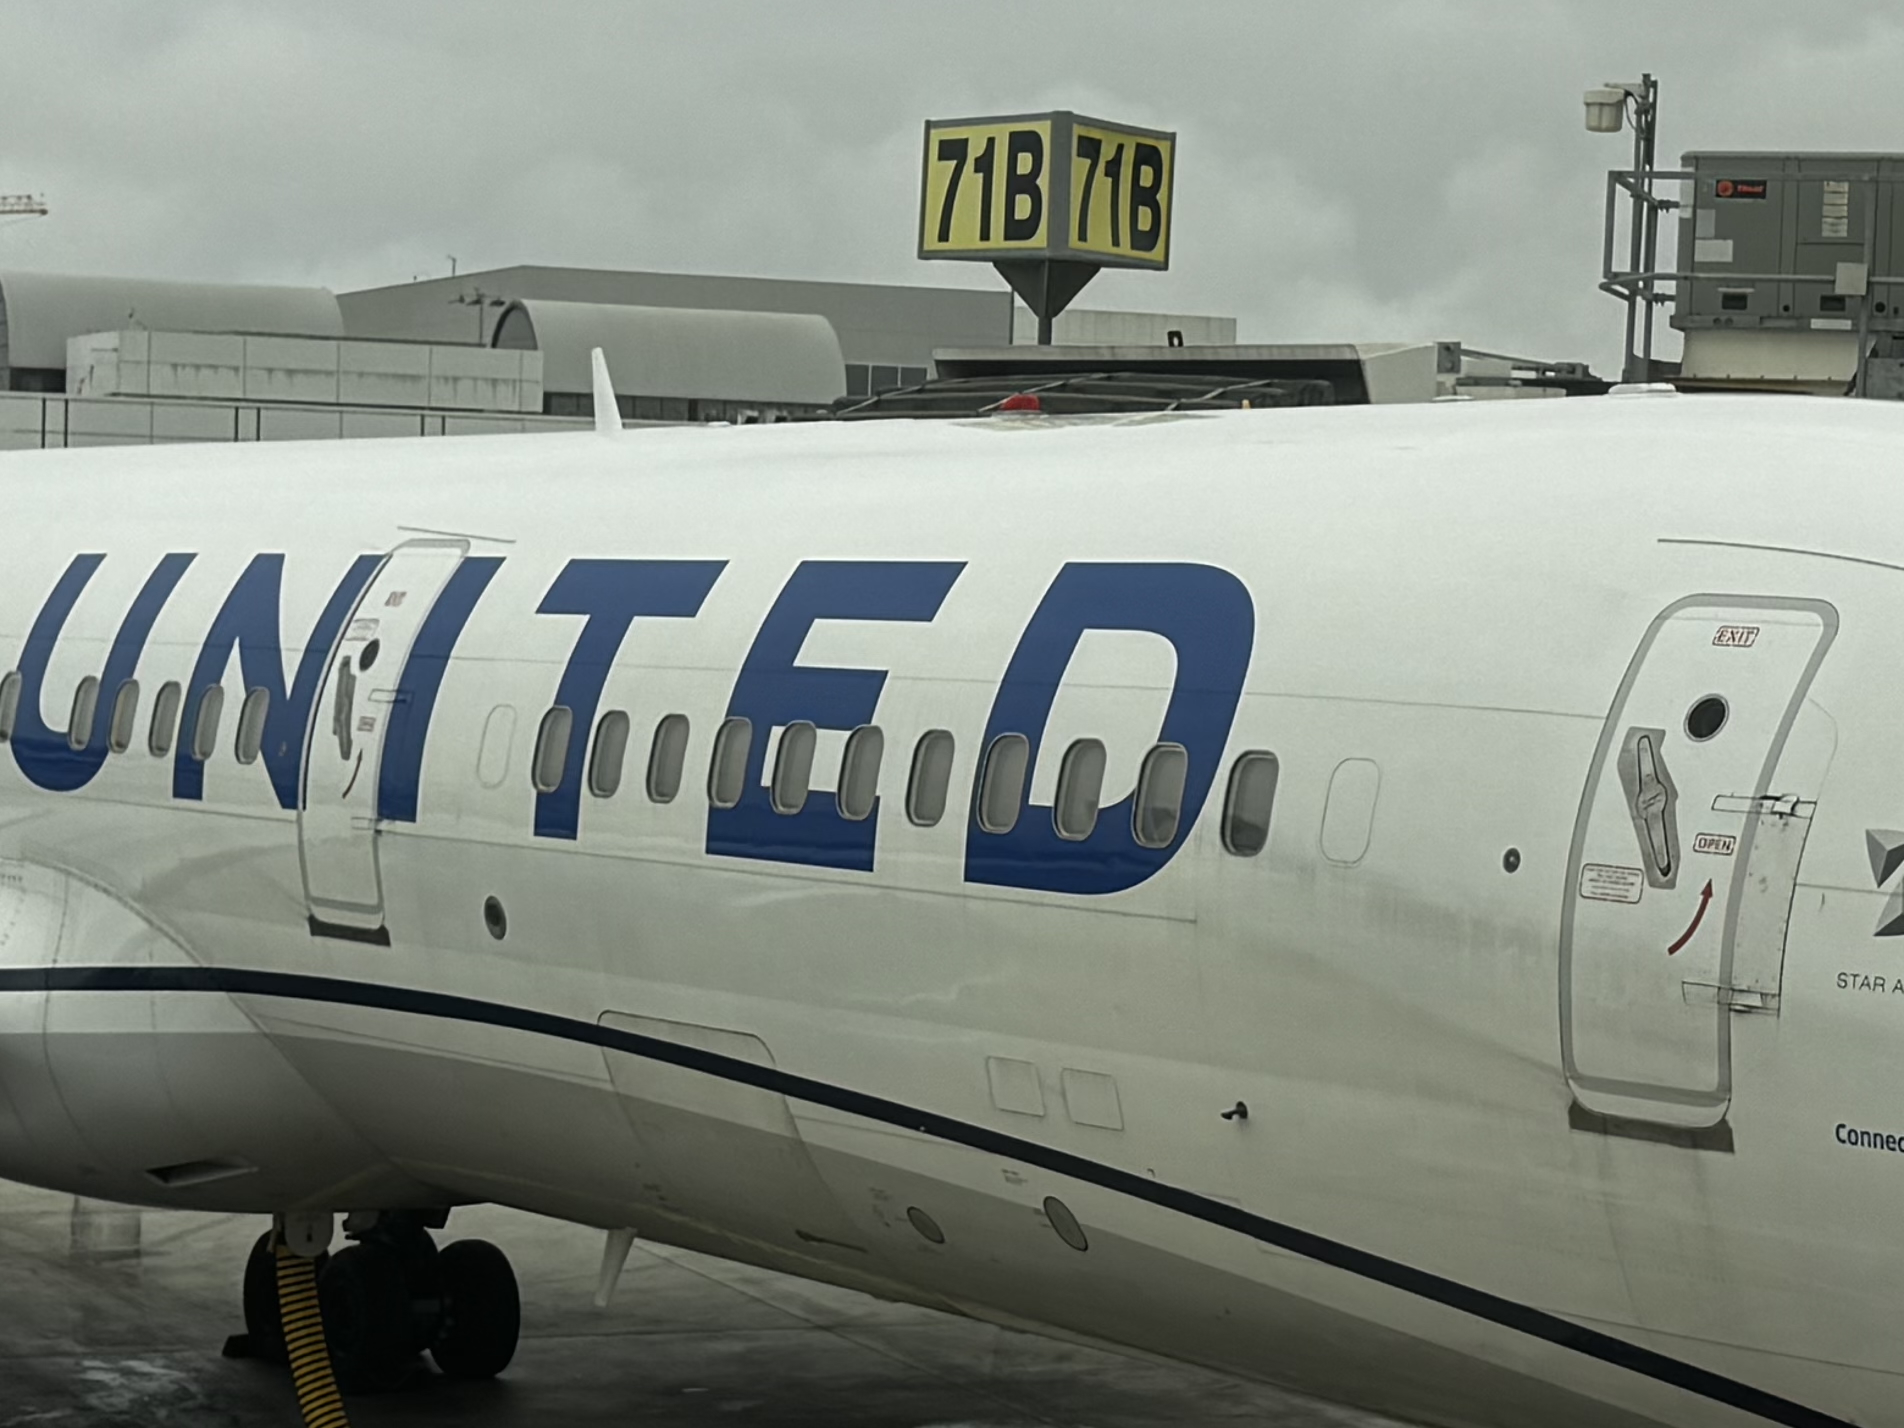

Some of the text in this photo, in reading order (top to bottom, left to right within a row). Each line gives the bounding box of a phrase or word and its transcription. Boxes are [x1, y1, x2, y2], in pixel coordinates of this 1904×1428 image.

[937, 130, 1044, 243] 71B
[1075, 134, 1164, 252] 71B
[1716, 629, 1755, 644] EXIT
[8, 552, 1257, 896] UNITED
[1698, 837, 1732, 852] OPEN
[1836, 972, 1886, 995] STAR
